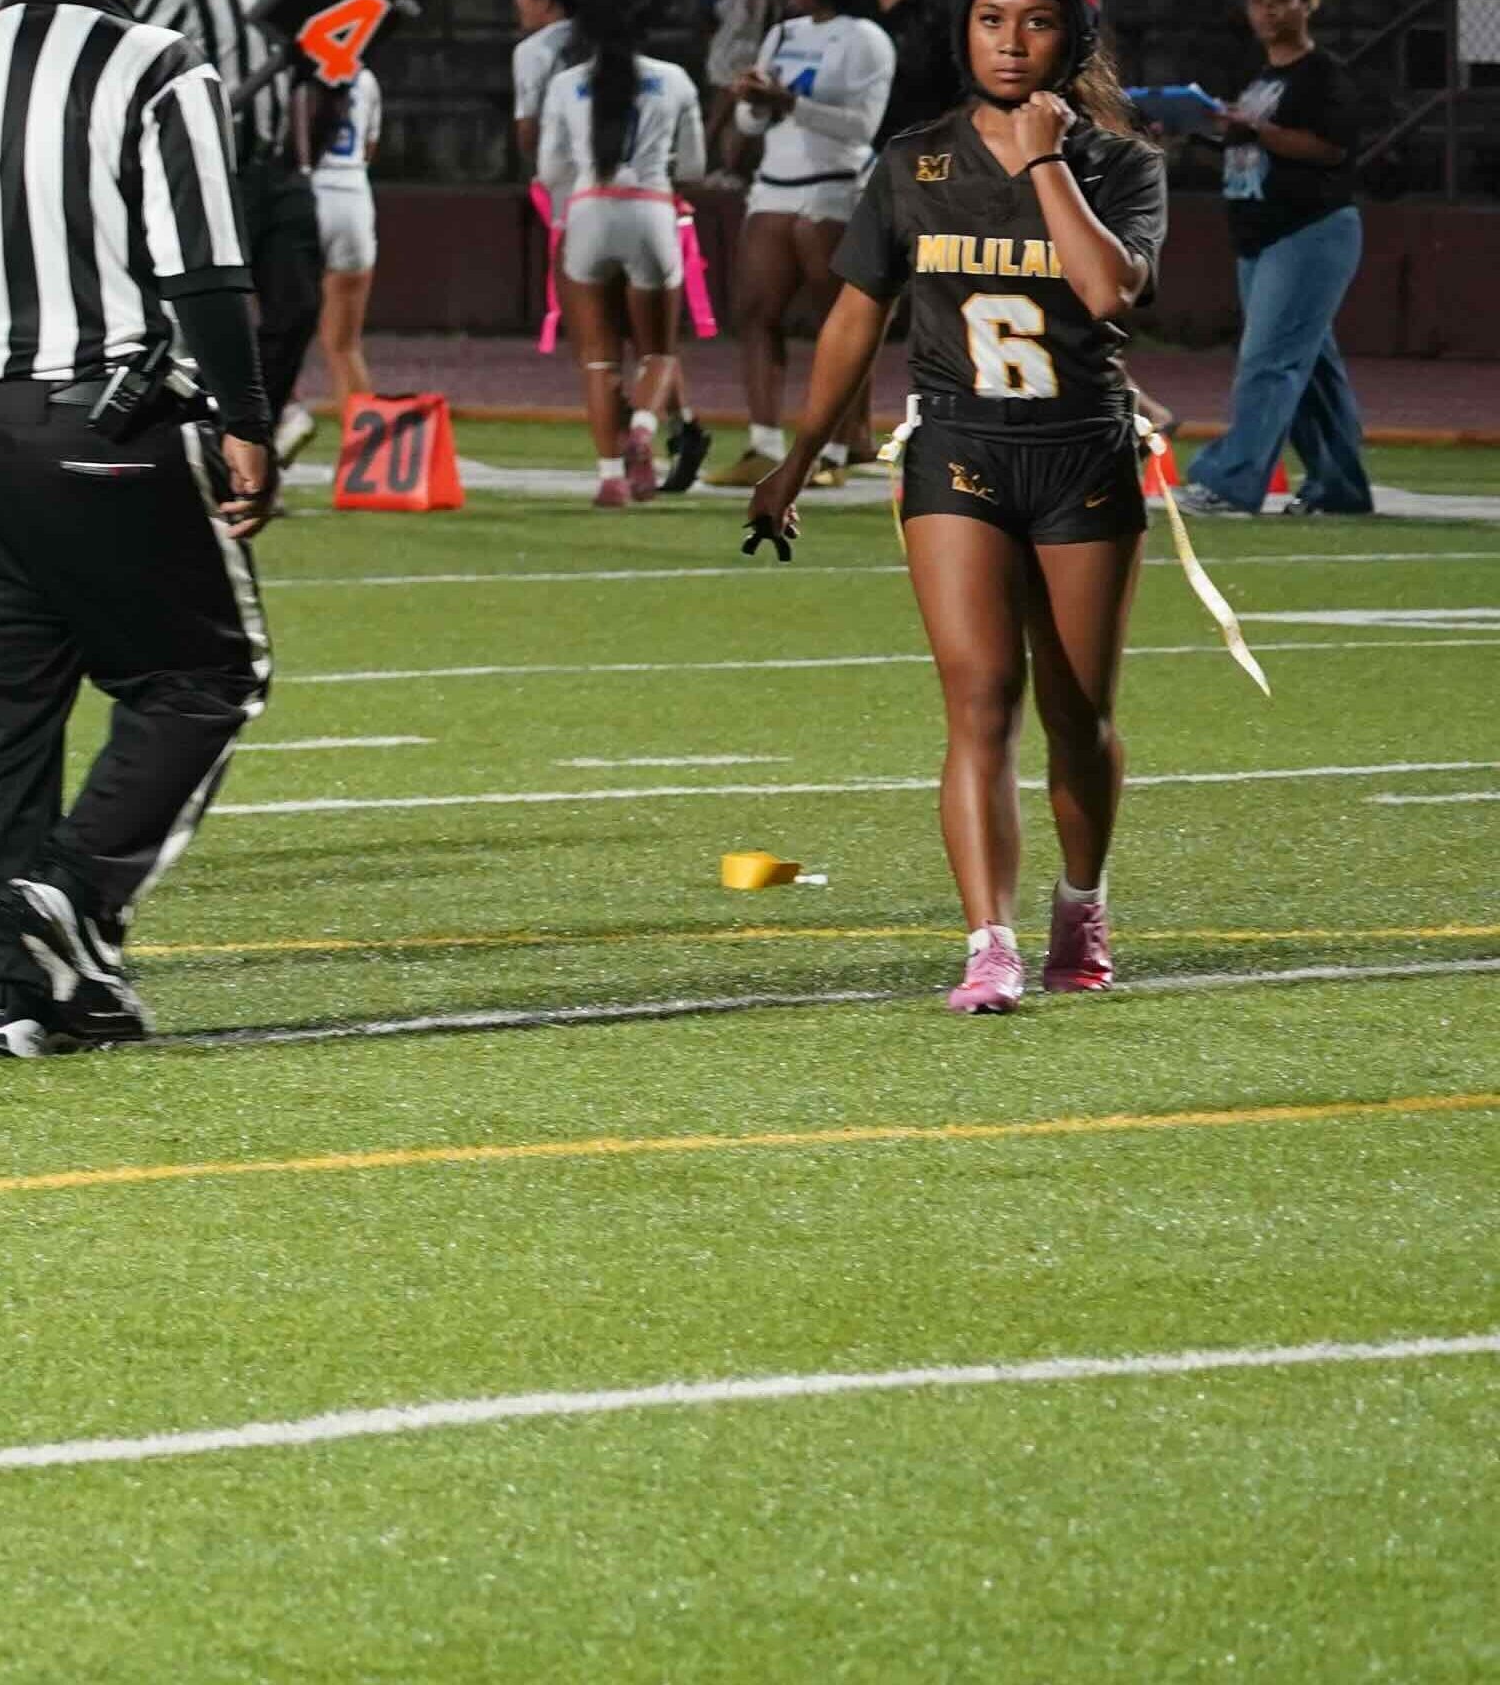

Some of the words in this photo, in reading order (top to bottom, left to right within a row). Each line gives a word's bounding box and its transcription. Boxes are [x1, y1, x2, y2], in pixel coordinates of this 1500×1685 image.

[915, 234, 1066, 278] MILILA
[960, 293, 1060, 400] 6
[344, 409, 425, 494] 20
